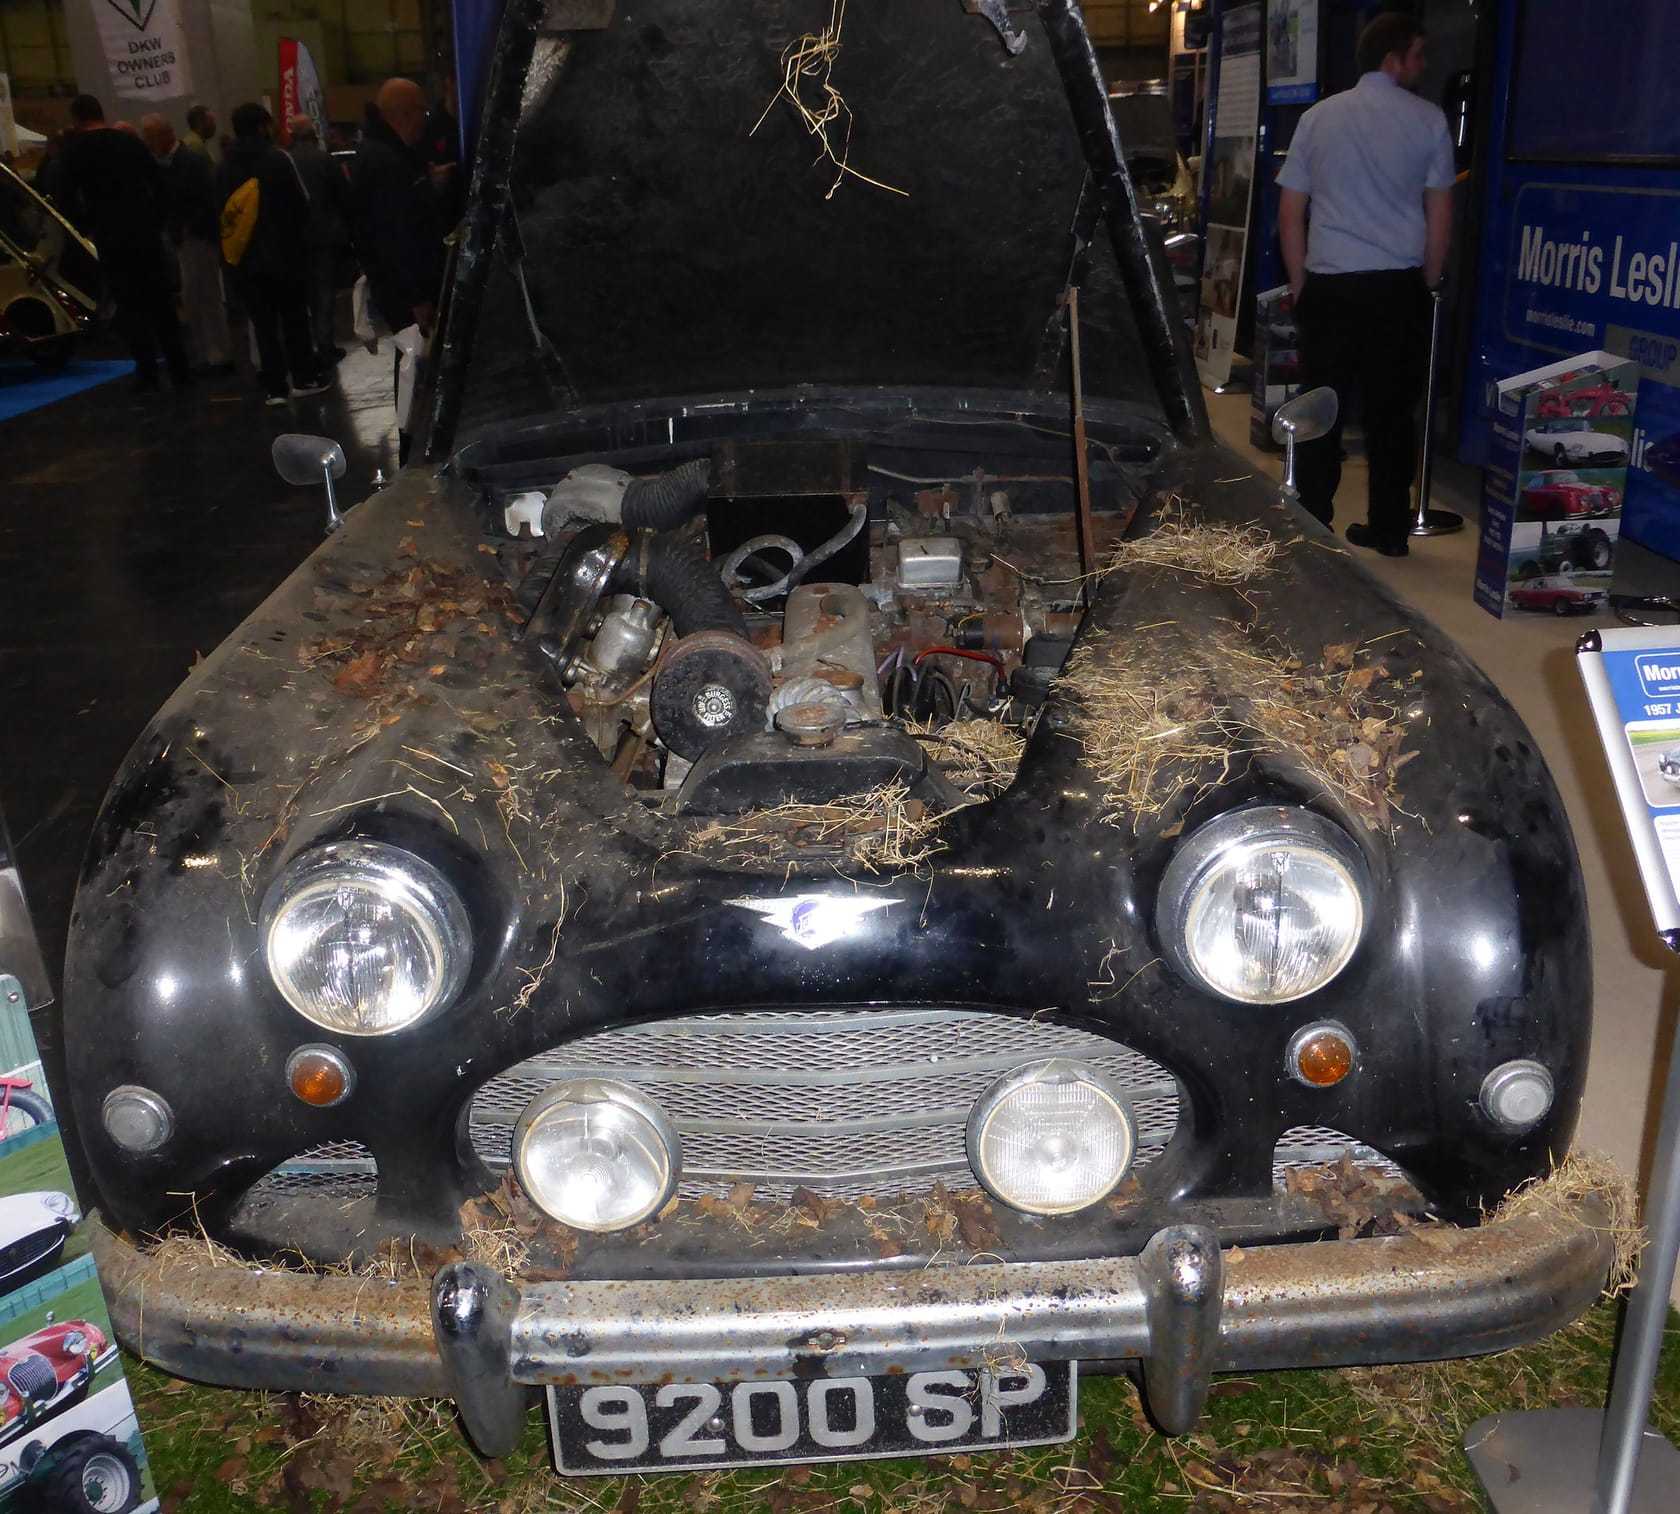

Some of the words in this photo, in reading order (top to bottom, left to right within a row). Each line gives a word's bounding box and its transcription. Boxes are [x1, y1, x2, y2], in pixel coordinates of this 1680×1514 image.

[127, 37, 162, 54] DKW
[117, 51, 176, 74] OWNERS
[134, 70, 171, 89] CLUB
[1518, 225, 1603, 294] Morris
[1643, 703, 1671, 716] 1957
[580, 1377, 875, 1459] 9200
[906, 1363, 1046, 1442] SP
